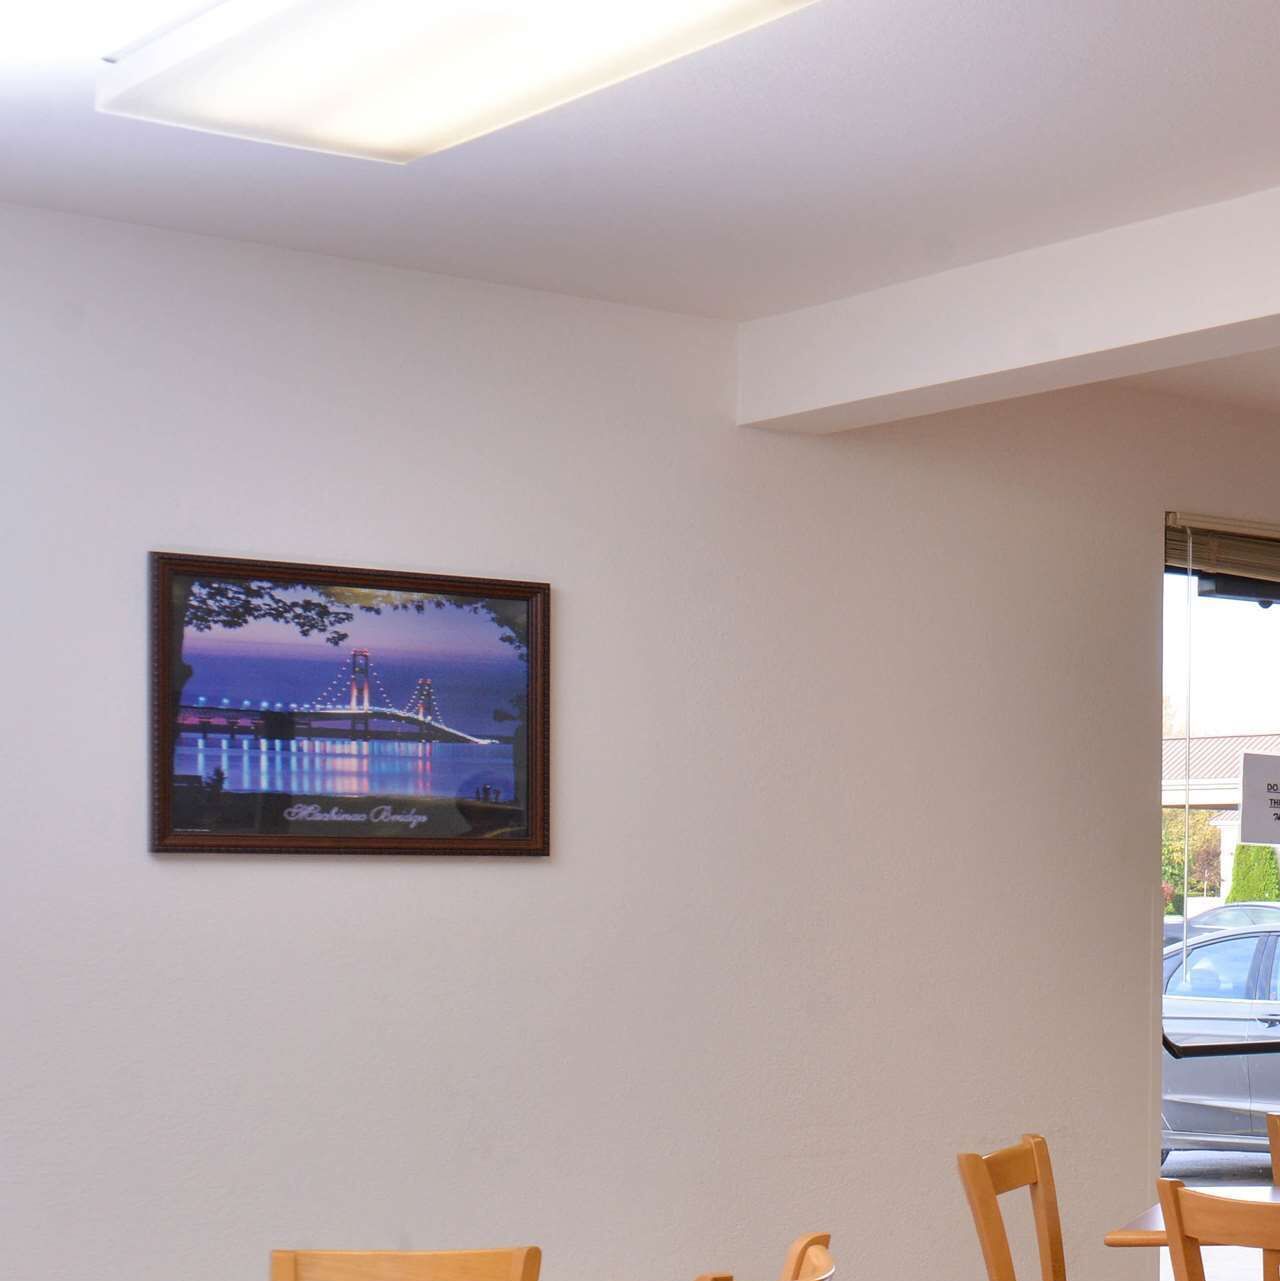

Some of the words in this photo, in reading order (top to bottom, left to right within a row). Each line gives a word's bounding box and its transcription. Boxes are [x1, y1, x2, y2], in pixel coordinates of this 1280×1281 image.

[1266, 783, 1279, 792] DO
[283, 803, 368, 822] Mackinac
[369, 805, 429, 829] Bridge
